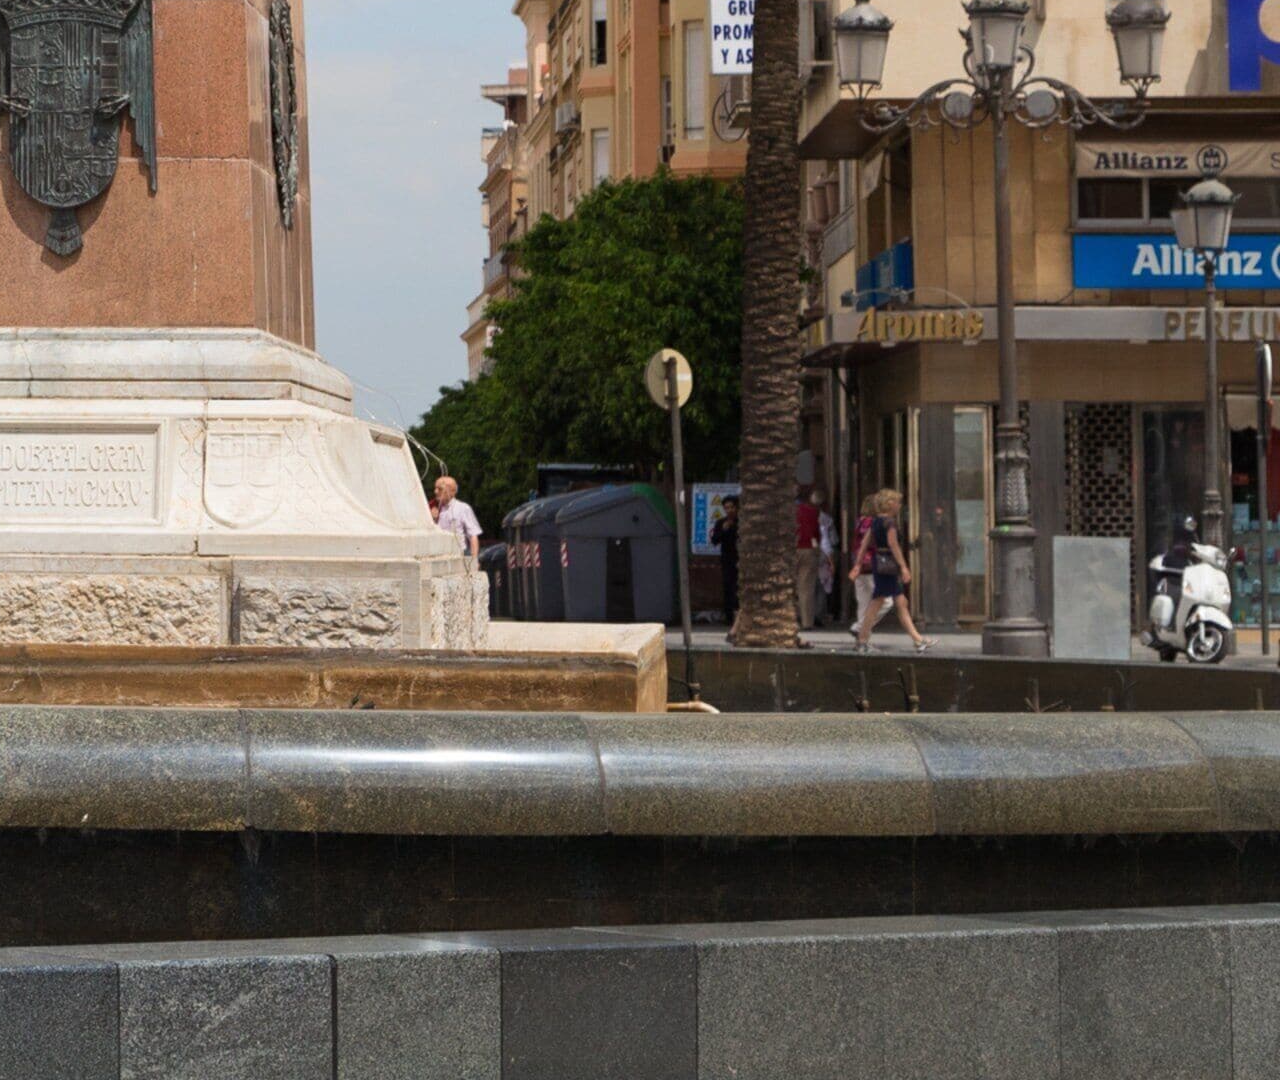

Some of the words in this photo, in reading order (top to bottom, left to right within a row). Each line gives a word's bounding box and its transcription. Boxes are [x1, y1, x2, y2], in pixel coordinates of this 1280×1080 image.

[721, 48, 729, 65] Y
[1094, 152, 1189, 170] Allianz
[1132, 243, 1263, 276] Allianz
[858, 306, 984, 341] Aromas
[1164, 310, 1280, 341] PERFU
